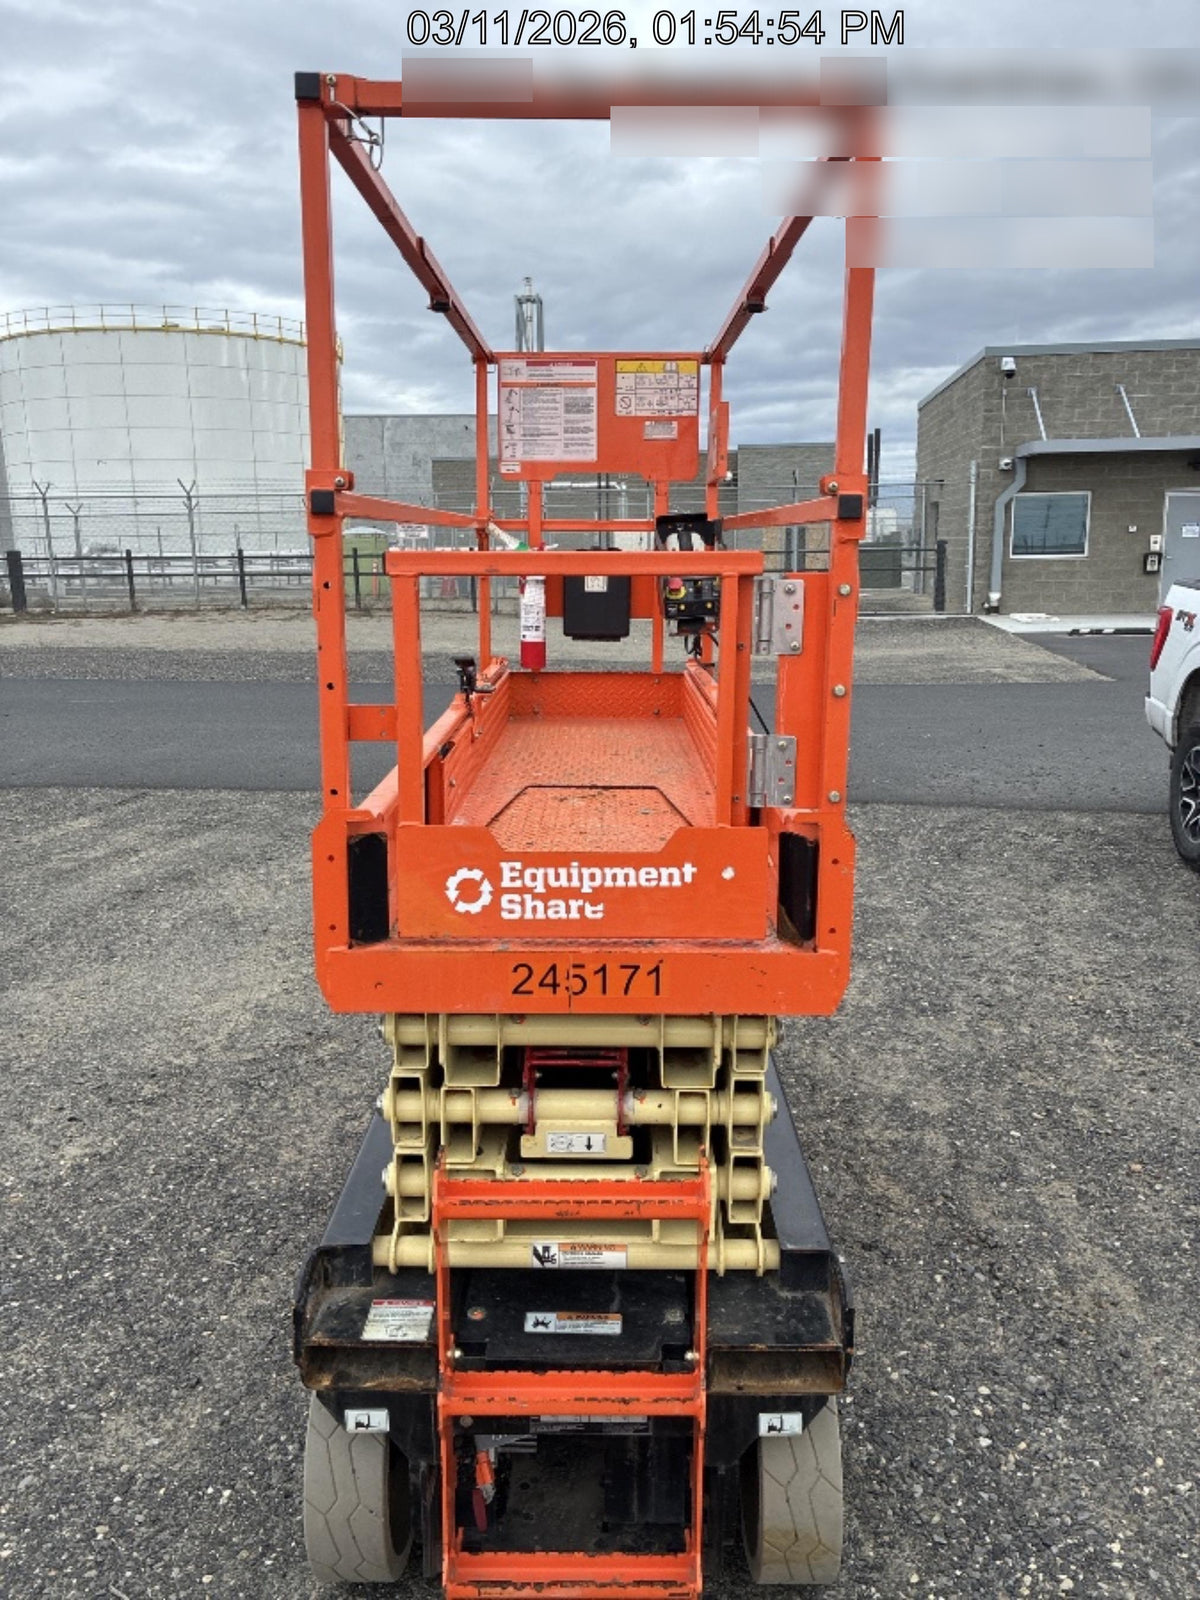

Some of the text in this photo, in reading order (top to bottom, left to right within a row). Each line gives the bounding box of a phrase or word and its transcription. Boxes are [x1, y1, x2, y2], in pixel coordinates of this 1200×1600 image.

[500, 861, 697, 893] Equipment
[500, 893, 605, 920] Share
[511, 961, 663, 996] 245171
